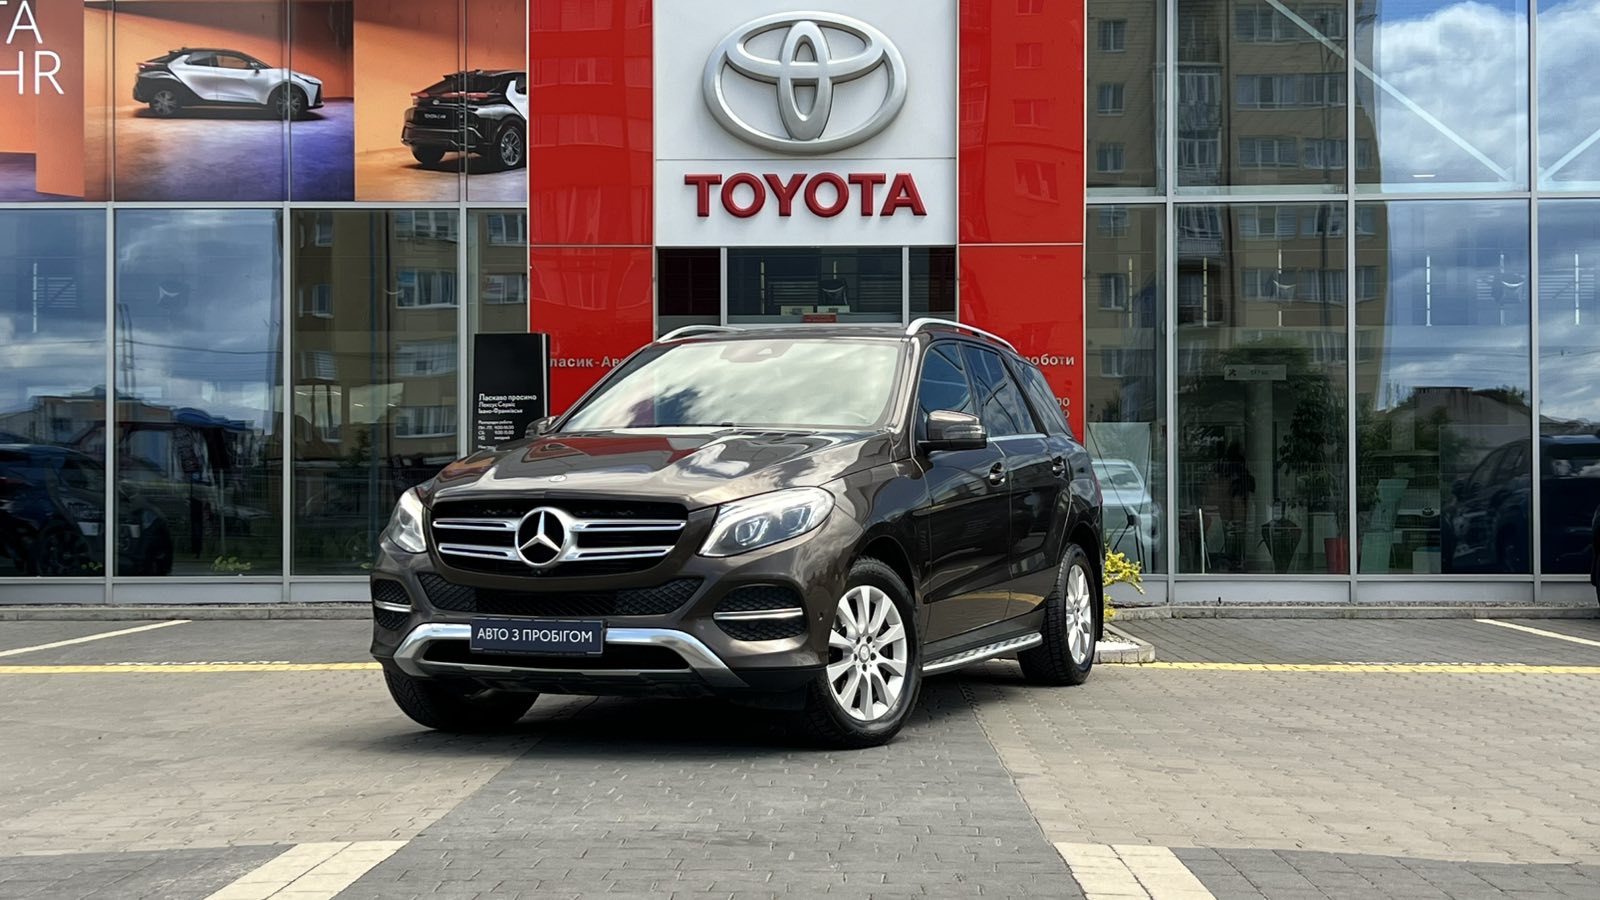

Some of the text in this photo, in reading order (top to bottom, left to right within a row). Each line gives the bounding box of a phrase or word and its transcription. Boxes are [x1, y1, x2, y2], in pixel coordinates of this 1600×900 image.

[0, 0, 43, 44] A
[684, 172, 928, 218] TOYOTA
[550, 355, 625, 368] ласик-Ав
[477, 627, 593, 643] АВТО З ПРОБІГОМ
